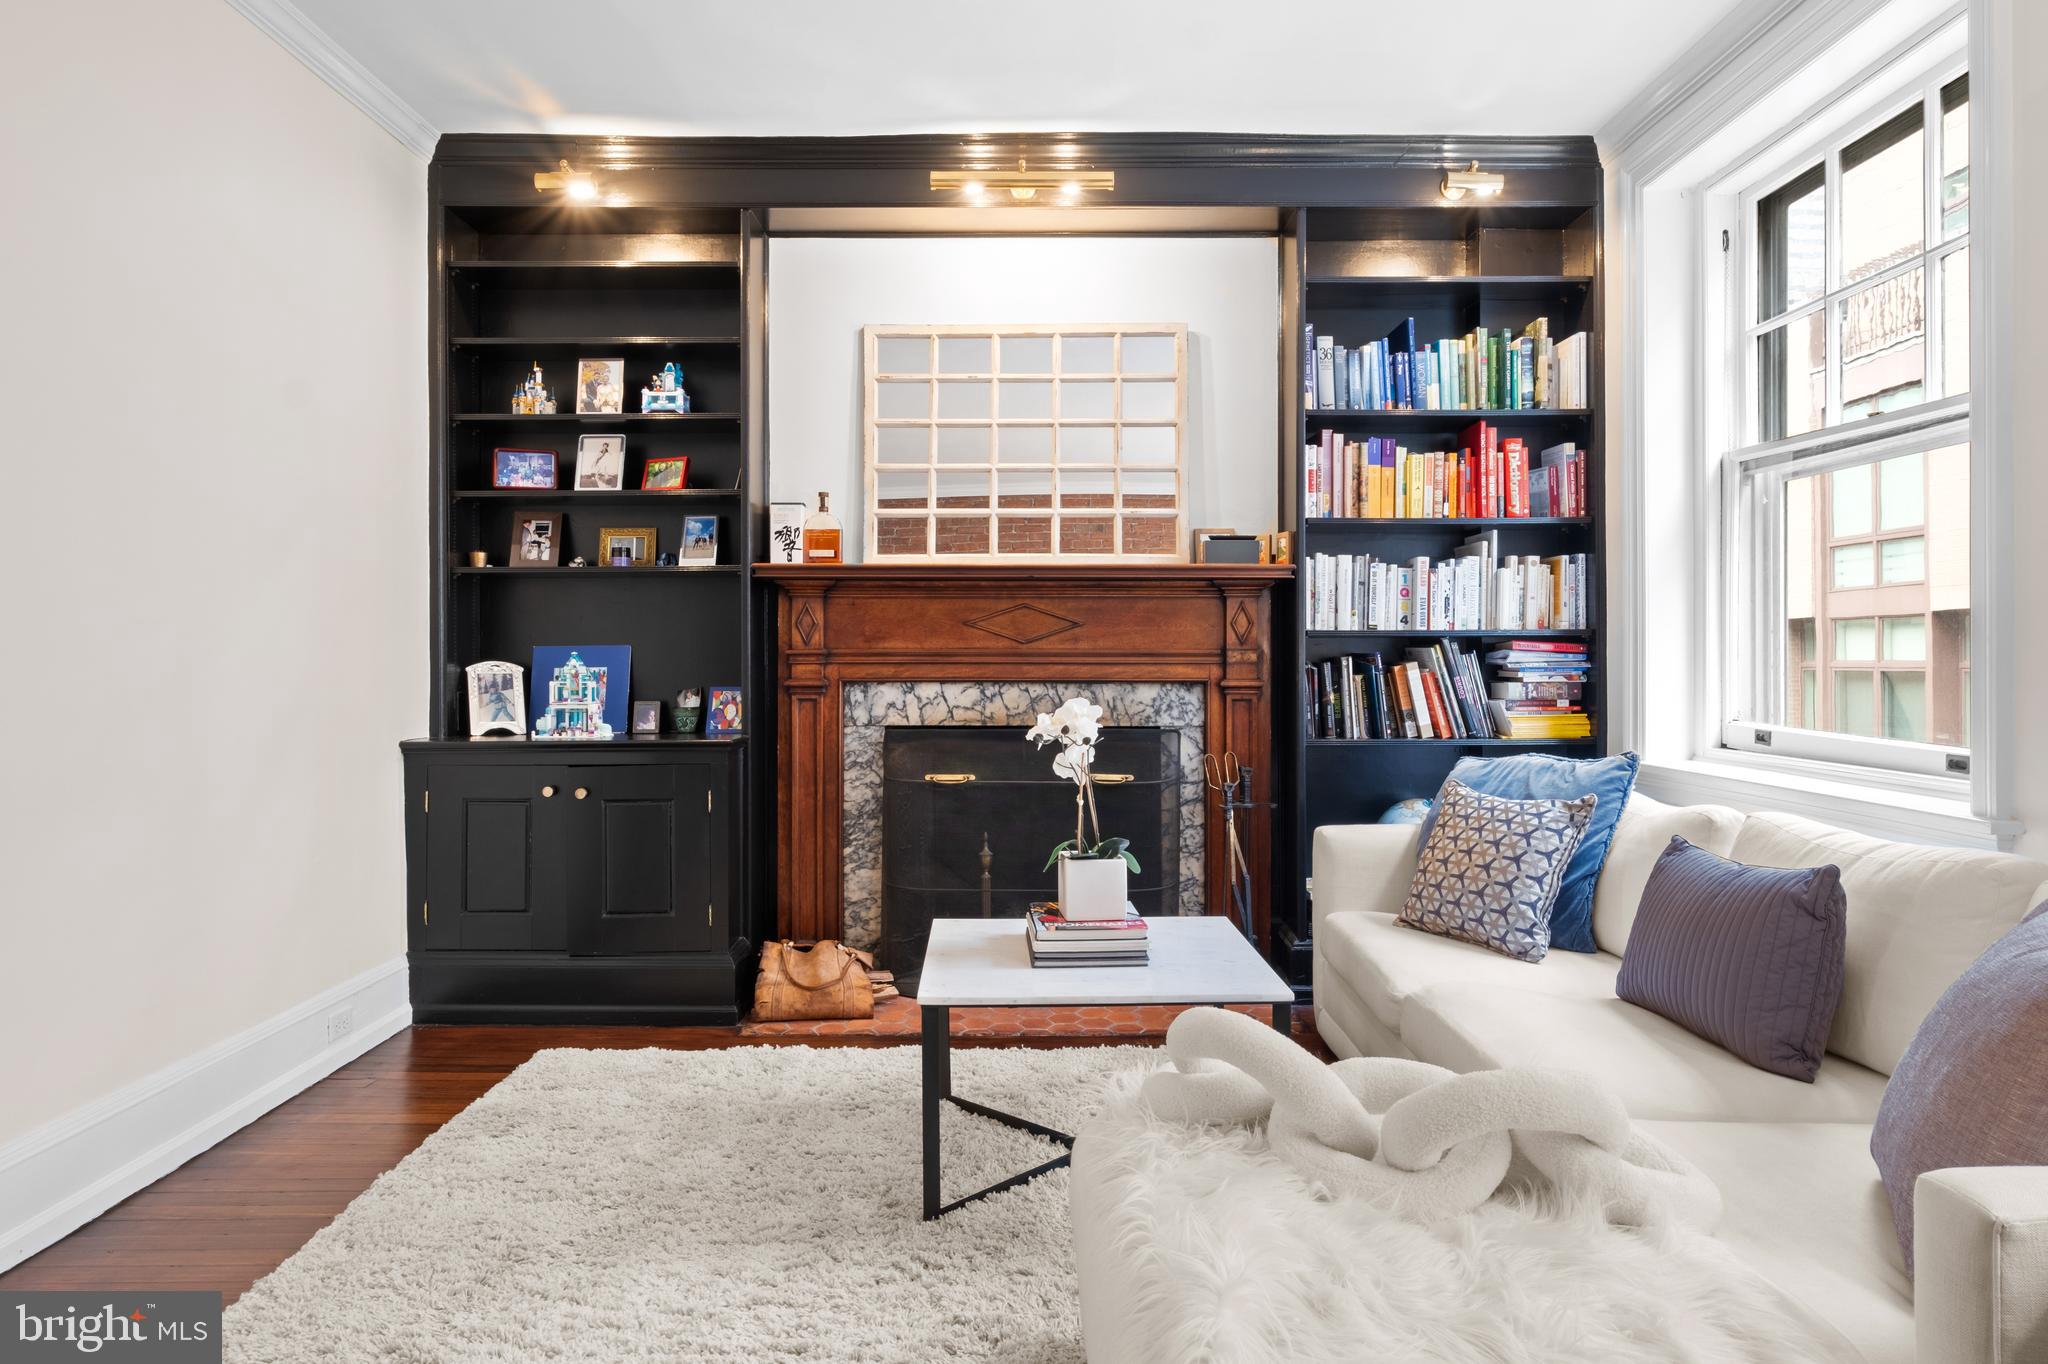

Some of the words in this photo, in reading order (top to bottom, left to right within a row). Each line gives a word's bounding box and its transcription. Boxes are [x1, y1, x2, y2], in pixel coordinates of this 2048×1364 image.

[1319, 347, 1333, 361] 36
[1417, 362, 1426, 399] WOMAN
[1508, 451, 1521, 514] Dictionary
